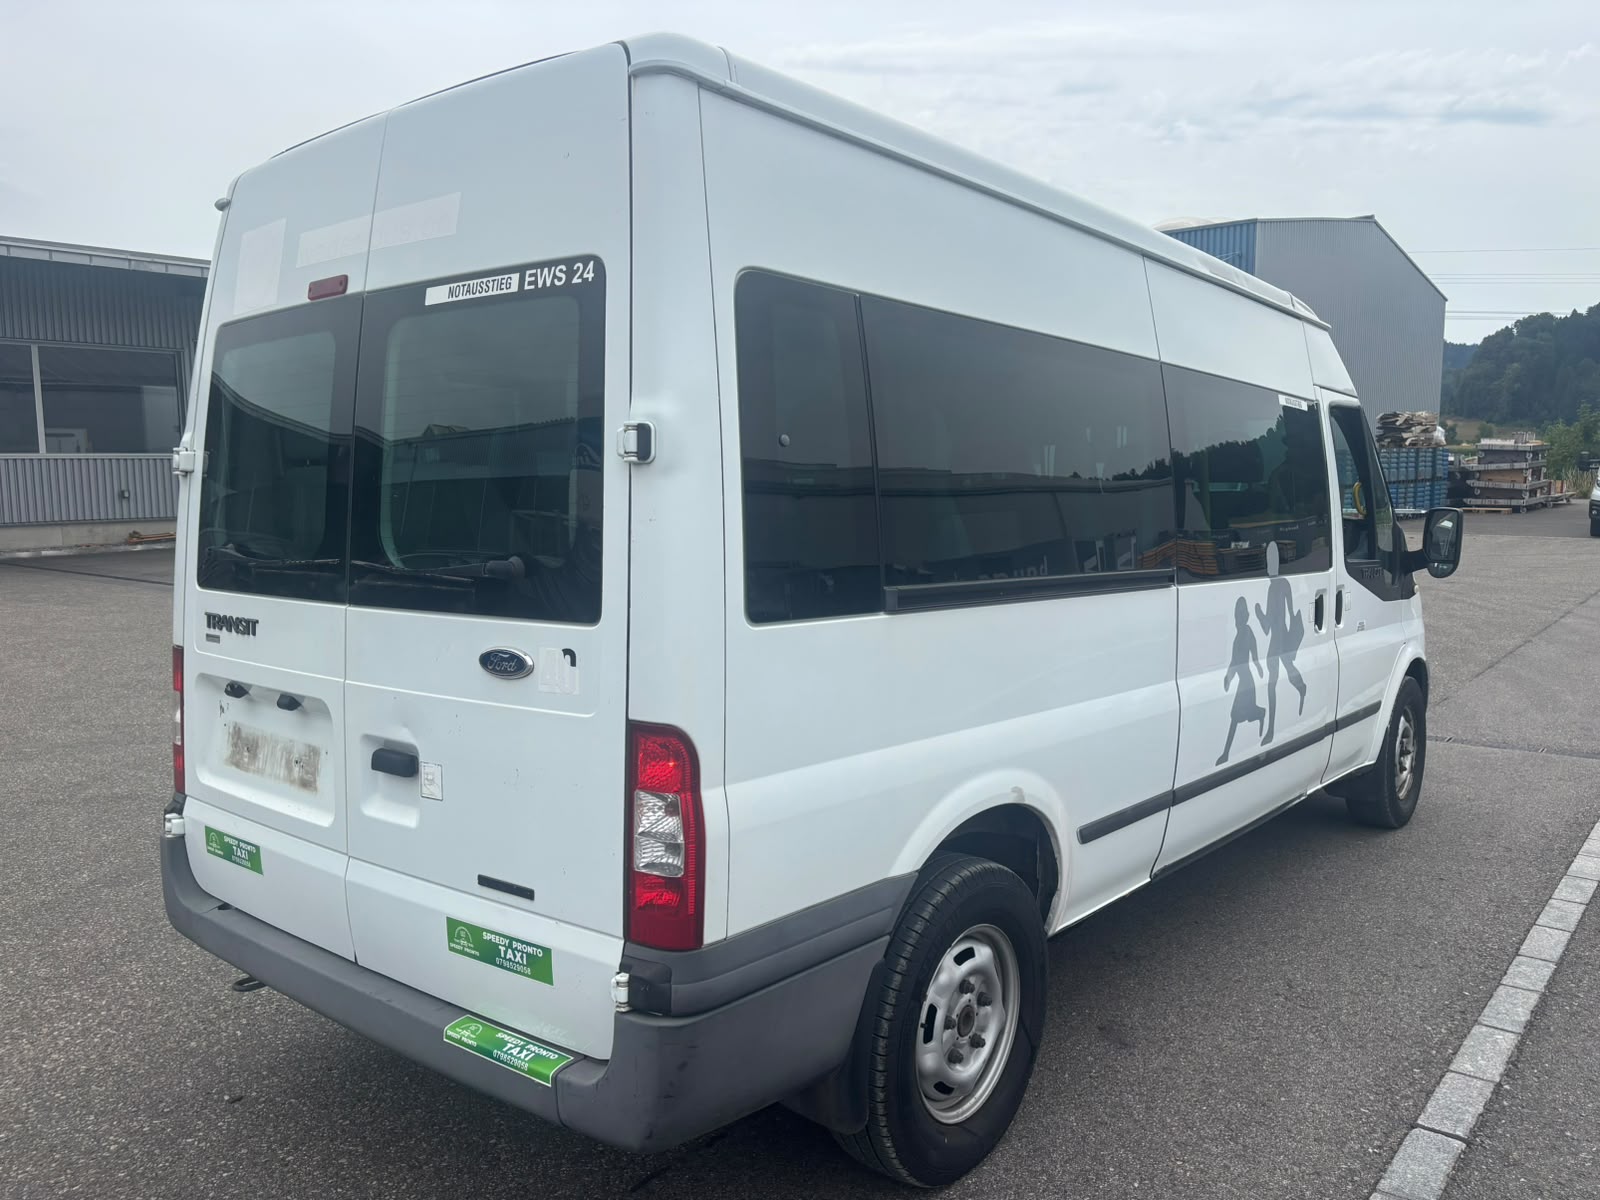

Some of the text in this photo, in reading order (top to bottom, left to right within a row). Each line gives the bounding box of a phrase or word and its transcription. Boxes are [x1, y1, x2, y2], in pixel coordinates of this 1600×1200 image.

[524, 260, 595, 290] EWS 24
[447, 276, 512, 299] NOTAUSSTIEG
[205, 611, 259, 637] TRANSIT
[487, 652, 517, 672] Ford
[233, 846, 249, 860] TAXI
[483, 932, 543, 957] SPEEDY PRONTO
[499, 945, 527, 965] TAXI
[496, 1033, 558, 1060] SPEEDY PRONTO
[502, 1043, 536, 1061] TAXI
[492, 1049, 529, 1072] 0798529058
